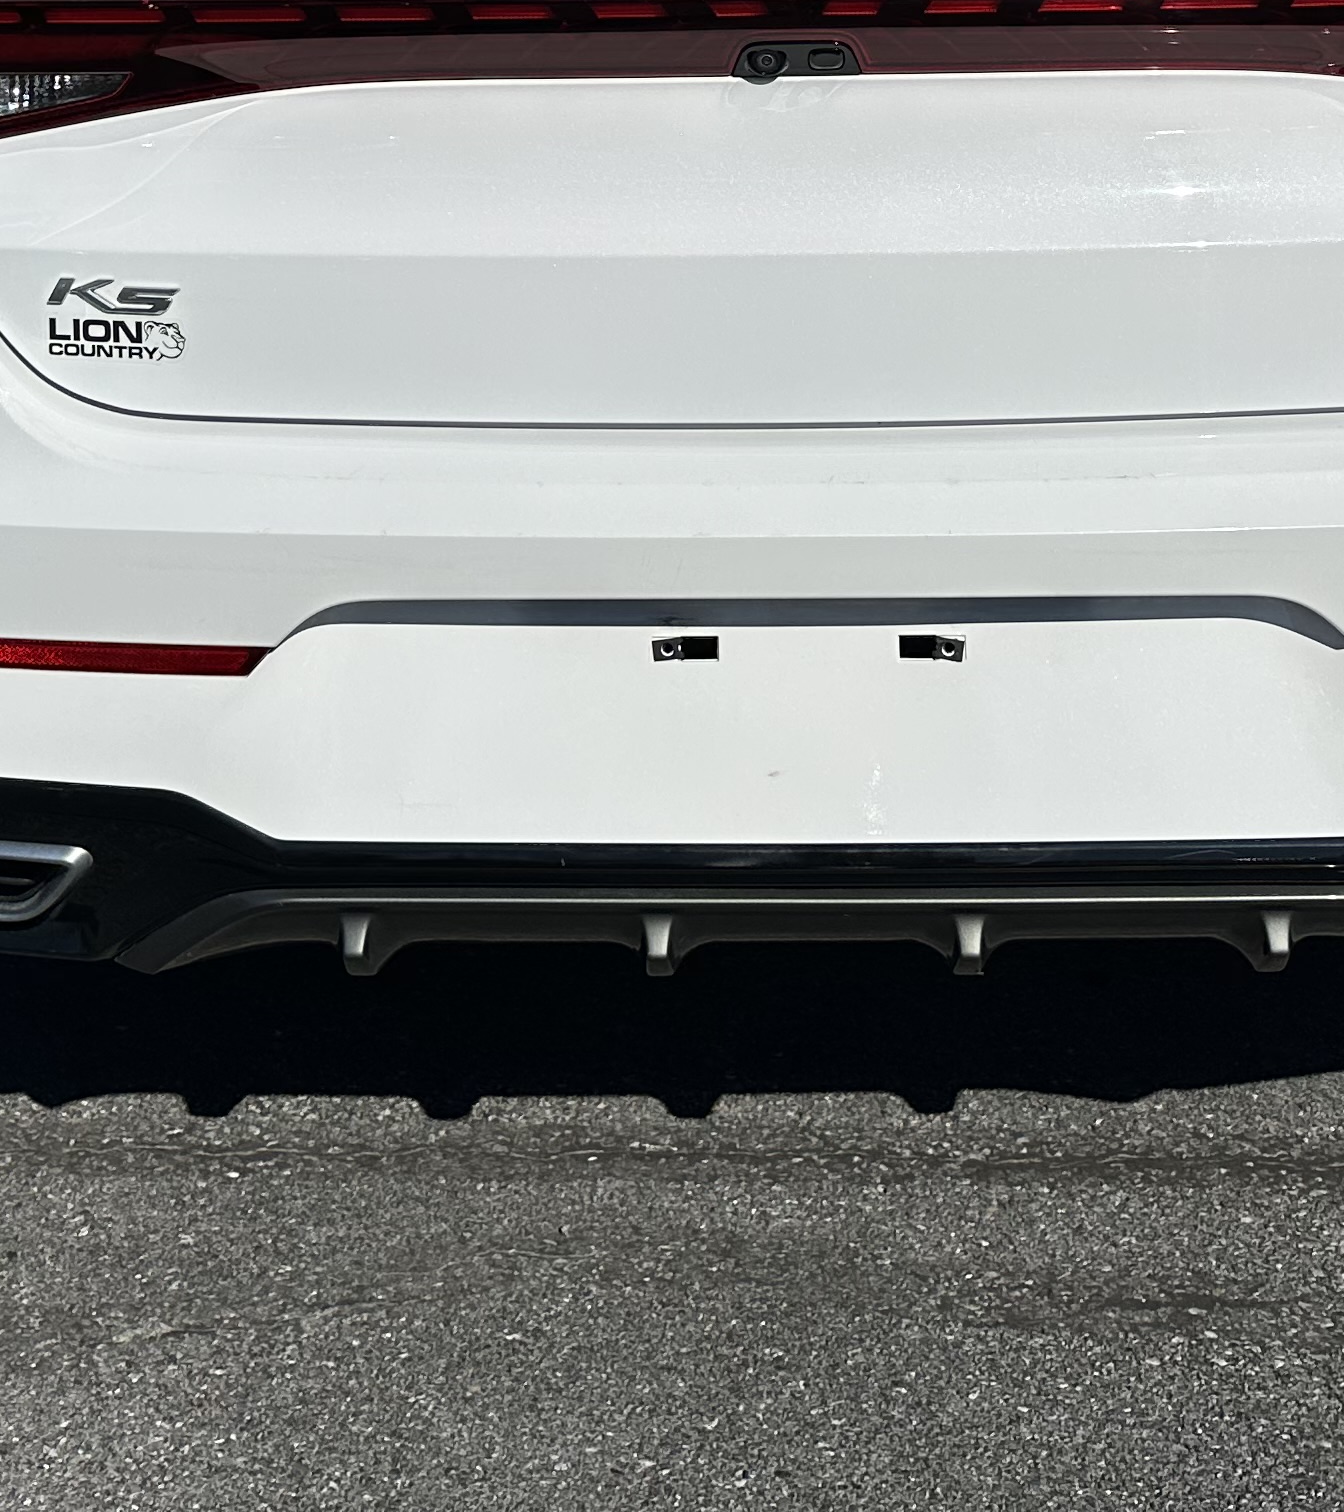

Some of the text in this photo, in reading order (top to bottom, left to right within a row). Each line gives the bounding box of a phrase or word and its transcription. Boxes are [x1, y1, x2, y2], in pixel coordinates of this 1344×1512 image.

[46, 277, 182, 316] K5
[48, 317, 143, 344] LION
[48, 342, 159, 360] COUNTRY
